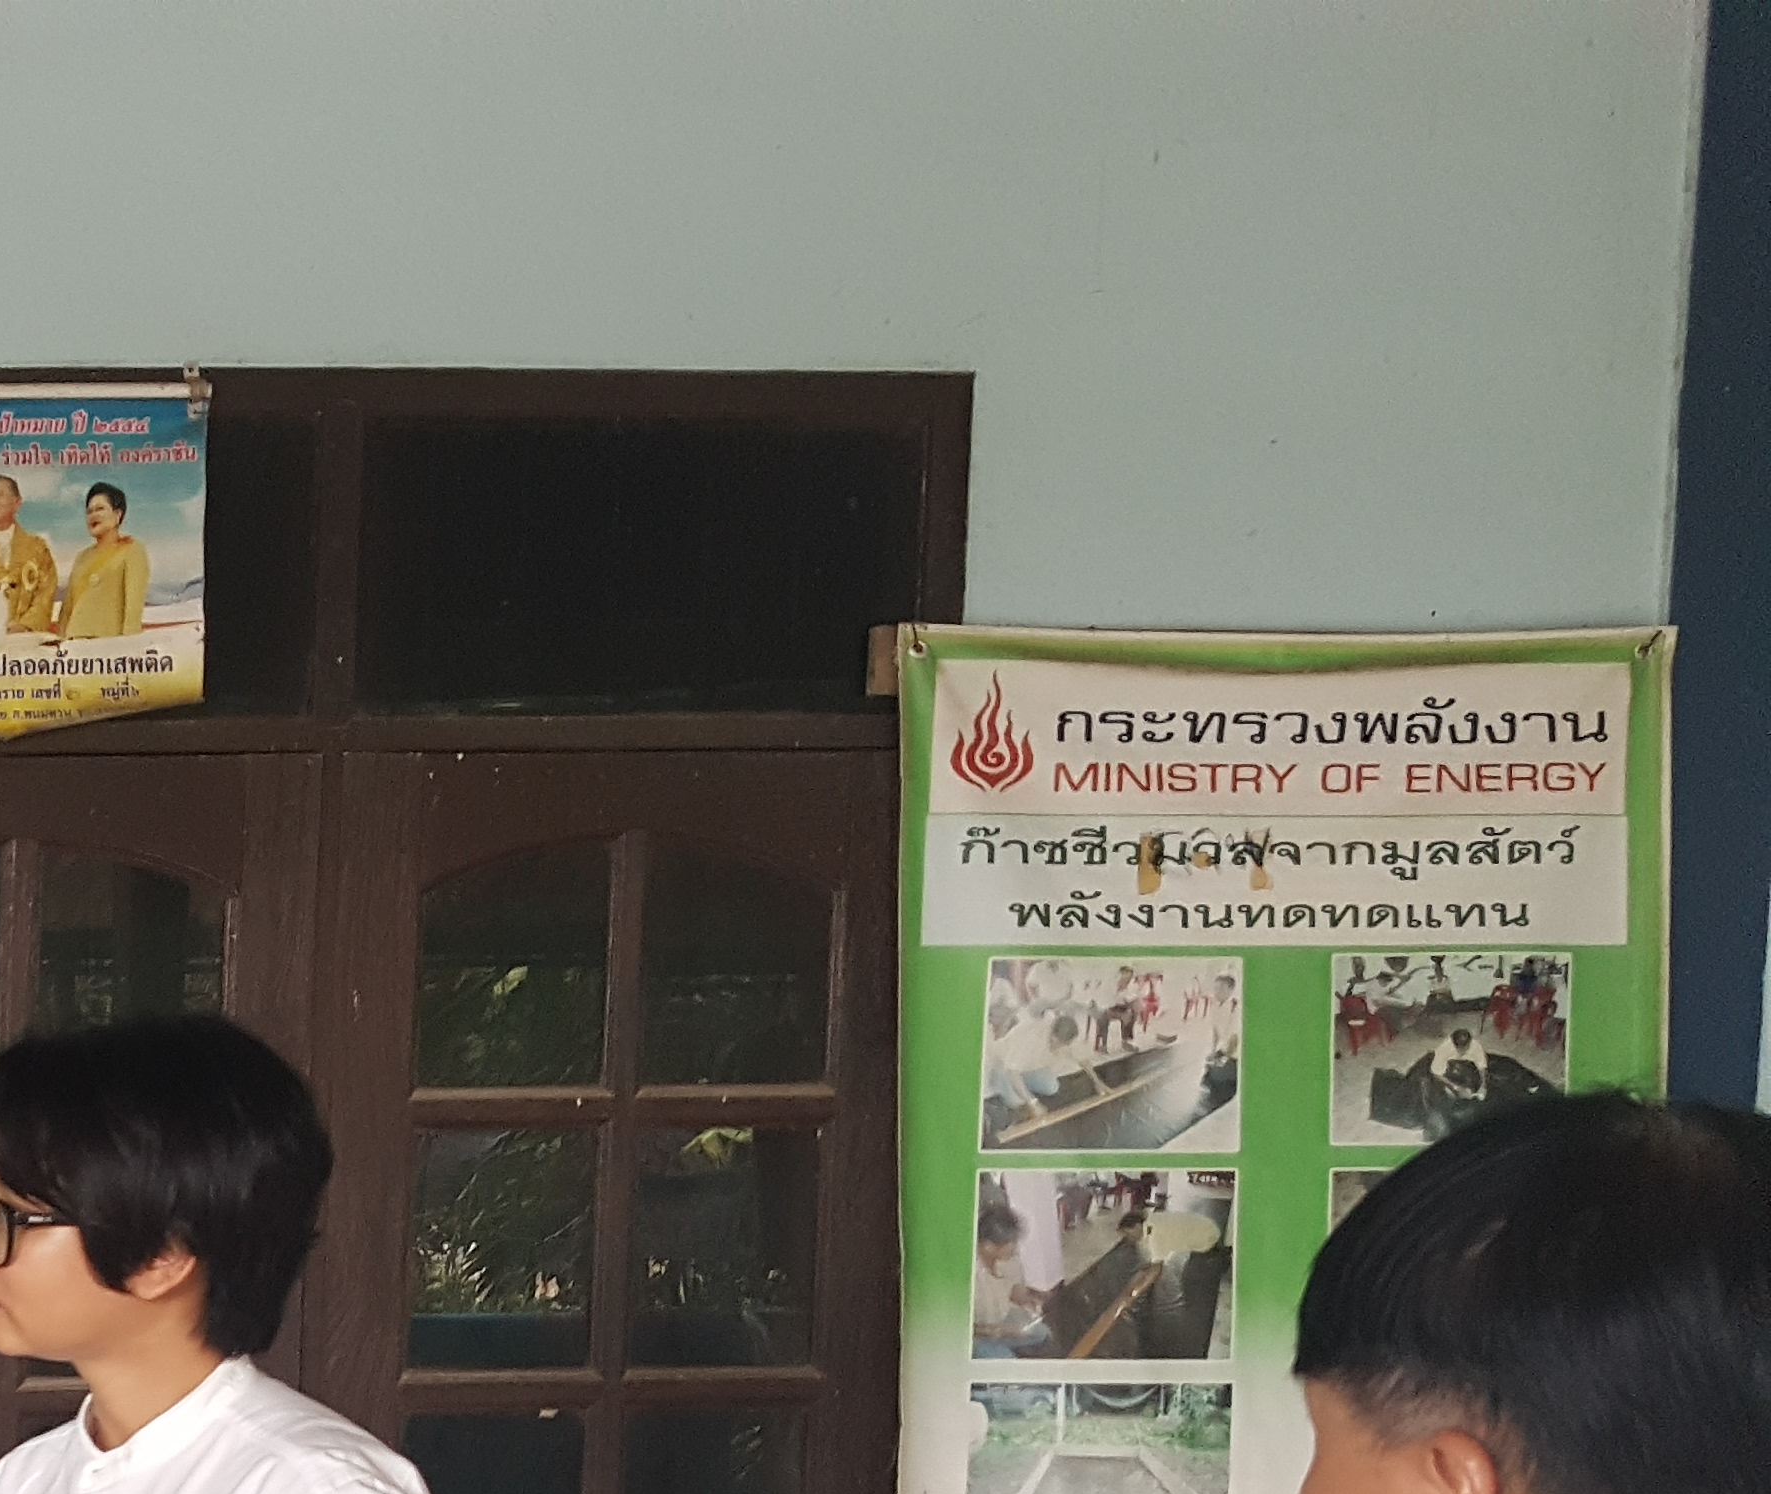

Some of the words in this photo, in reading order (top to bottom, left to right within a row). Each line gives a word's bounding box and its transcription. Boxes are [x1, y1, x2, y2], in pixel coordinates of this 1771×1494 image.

[1055, 697, 1609, 747] กระทรวงพลังงาน
[1053, 761, 1299, 793] MINISTRY
[1321, 762, 1383, 793] OF
[1405, 761, 1607, 793] ENERGY
[1009, 890, 1531, 930] พลังงานทดทดแทน
